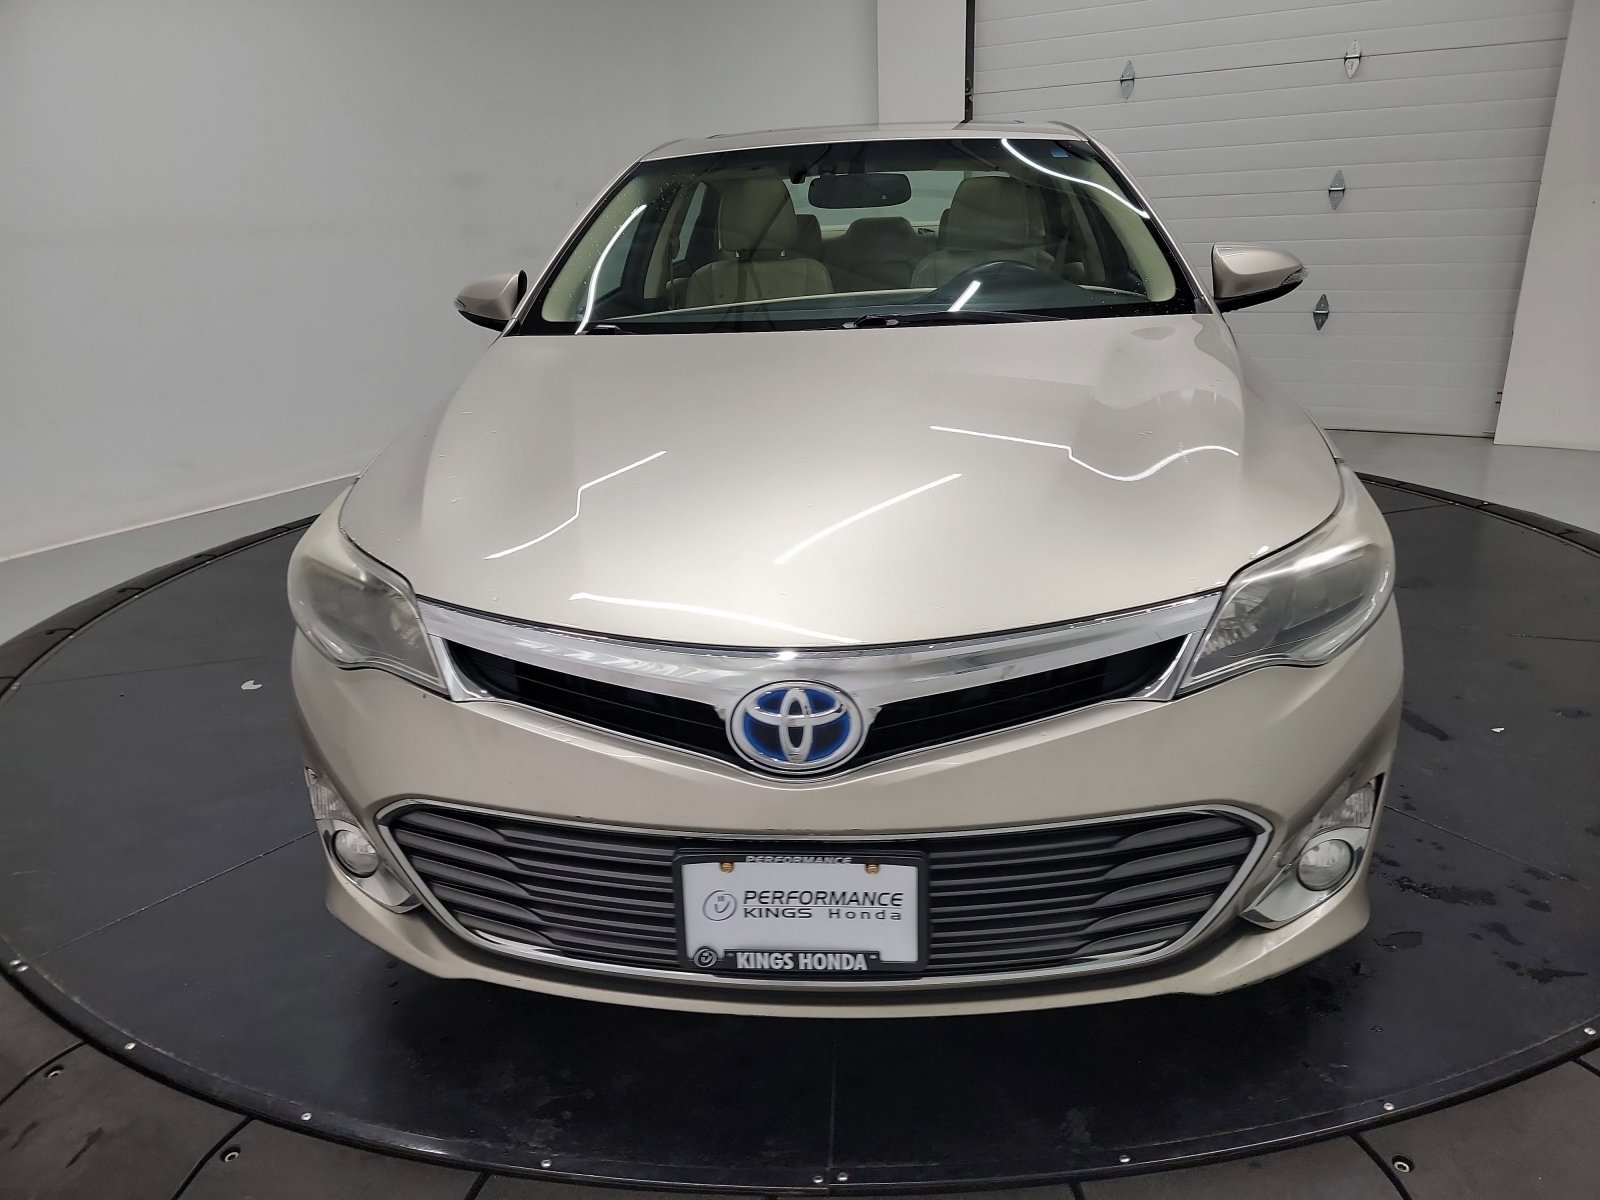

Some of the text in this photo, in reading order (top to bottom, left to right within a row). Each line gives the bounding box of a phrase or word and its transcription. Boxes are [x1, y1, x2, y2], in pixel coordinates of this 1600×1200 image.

[745, 856, 853, 864] PERFORMANCE
[743, 890, 904, 907] PERFORMANCE
[744, 907, 903, 921] KINGS Honda
[736, 952, 868, 970] KINGS HONDA
